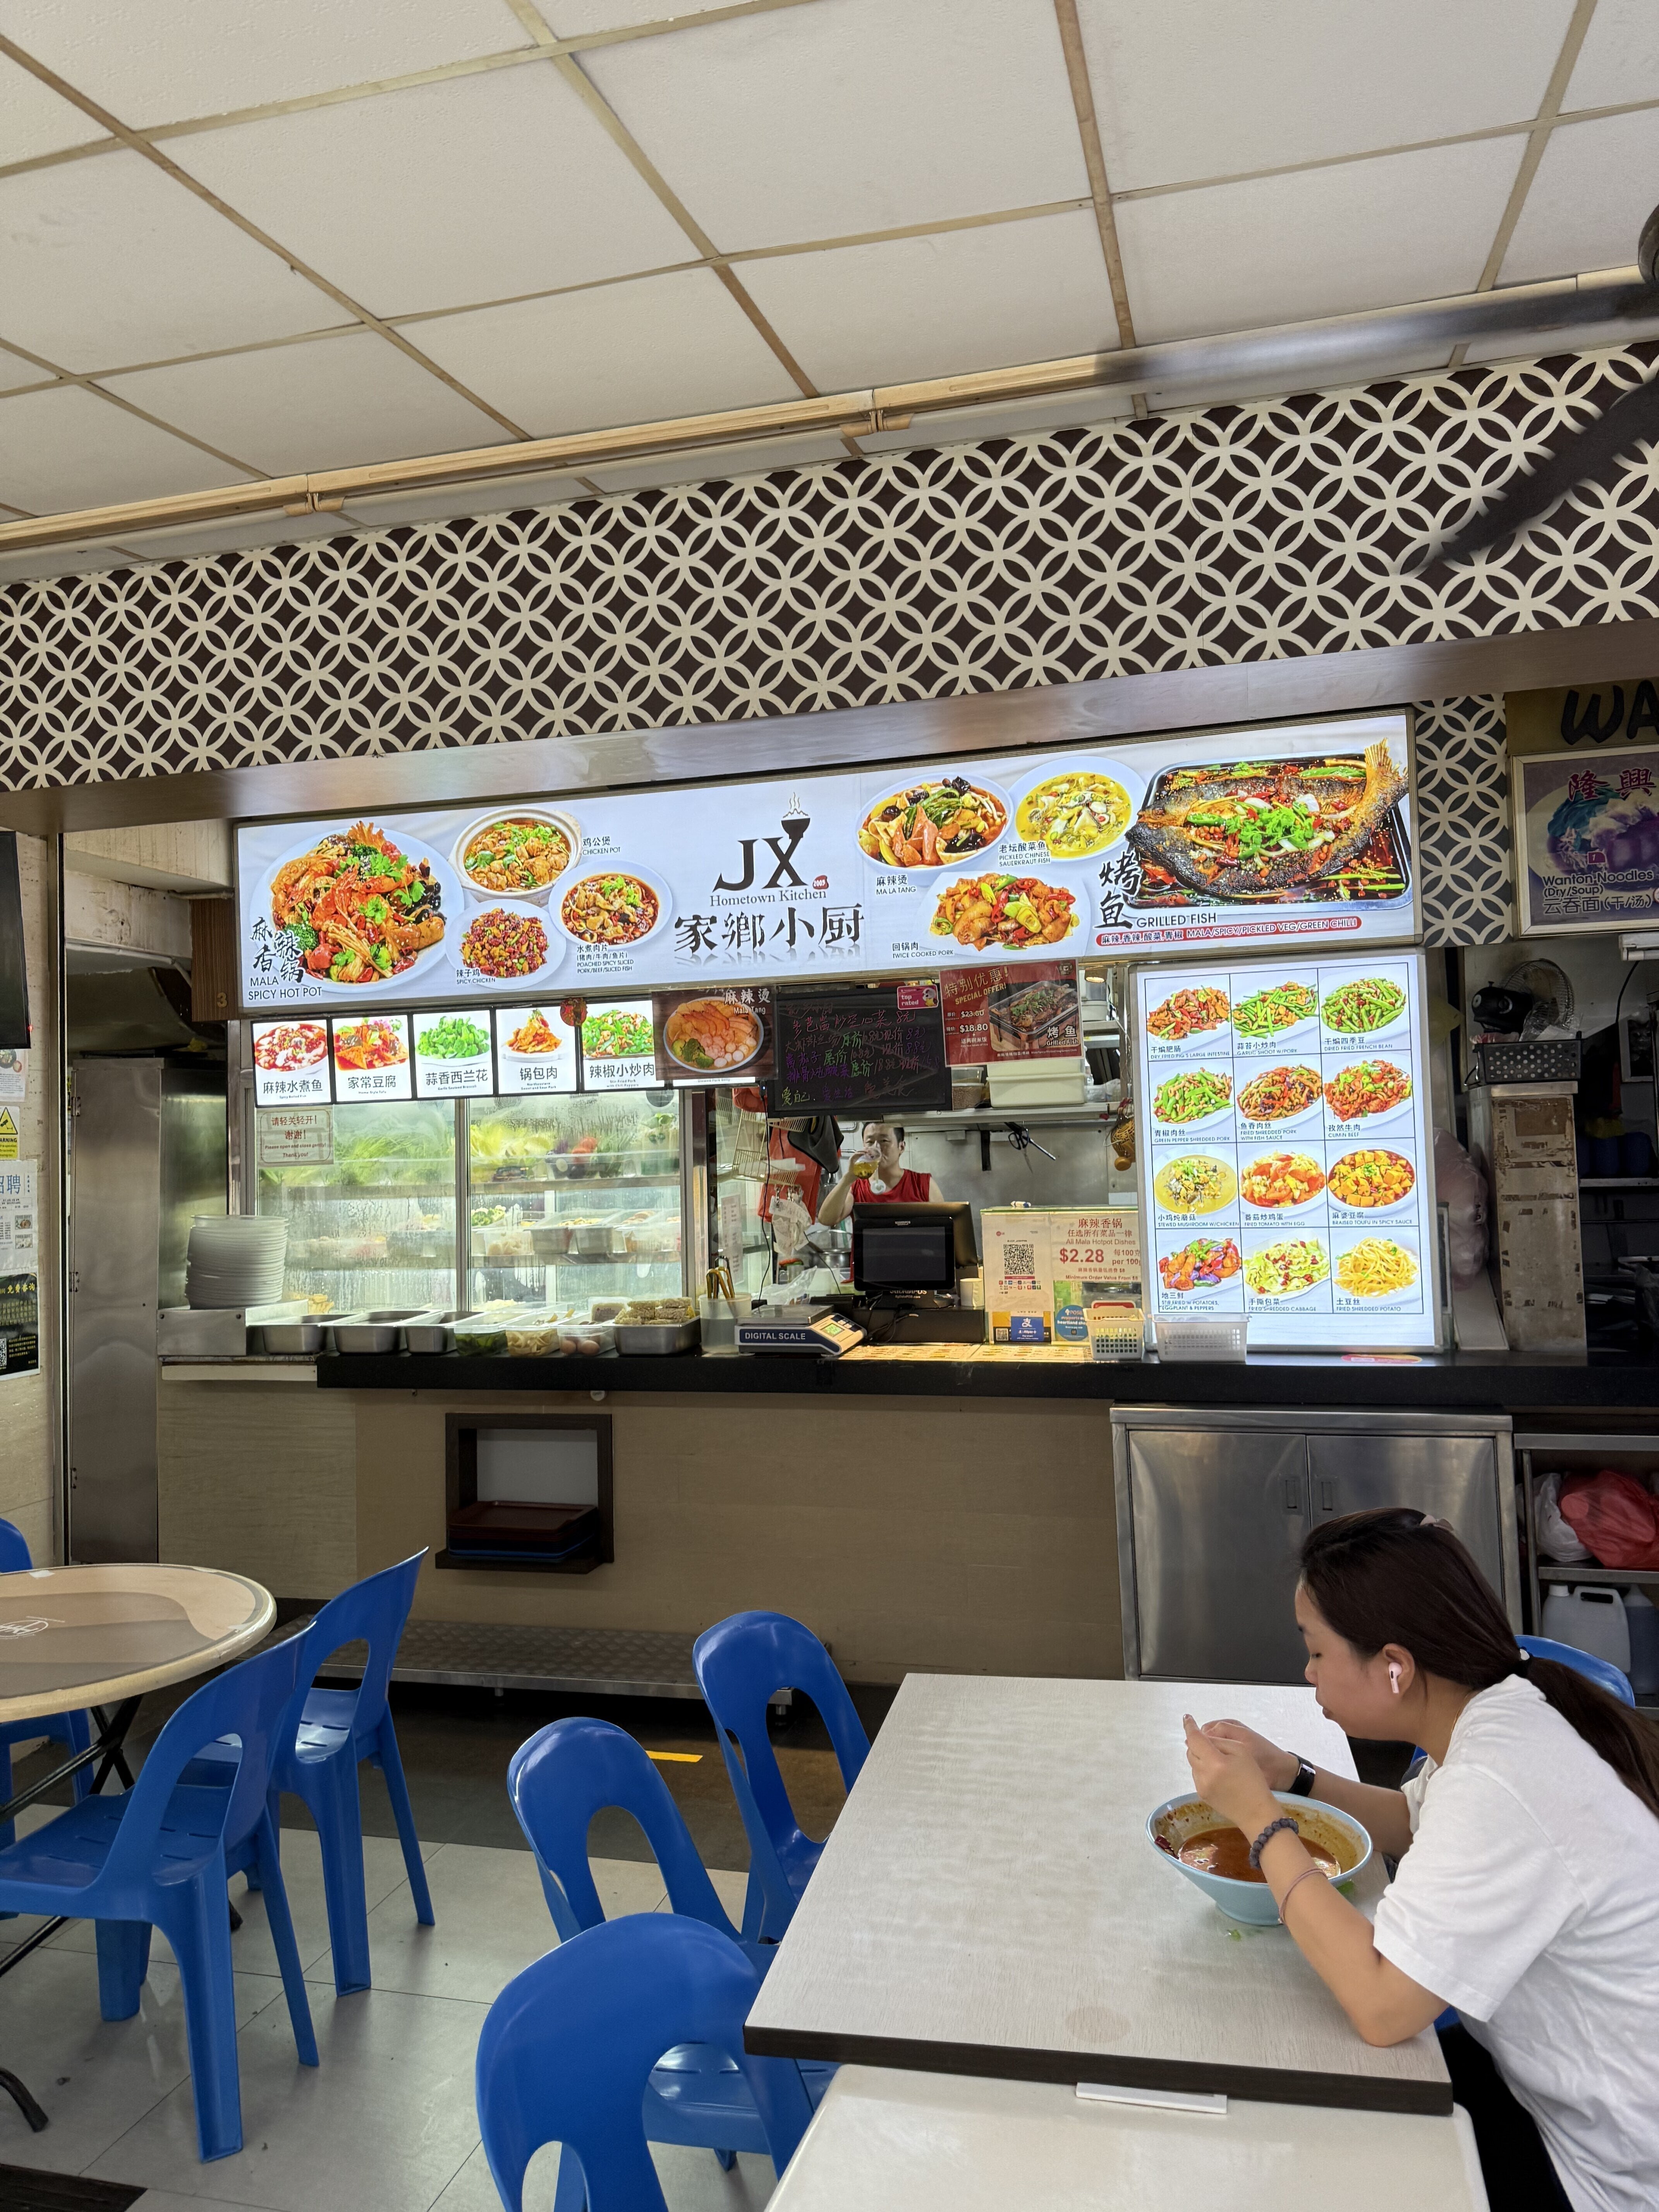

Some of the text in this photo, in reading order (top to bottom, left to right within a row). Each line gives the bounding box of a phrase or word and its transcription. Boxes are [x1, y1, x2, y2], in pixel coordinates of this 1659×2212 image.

[1568, 768, 1656, 802] 隆興
[583, 836, 610, 847] 鸡公煲
[999, 842, 1046, 853] 老坛酸菜鱼
[712, 836, 809, 892] JX
[876, 874, 907, 886] 麻辣烫
[1543, 871, 1653, 886] Wanton Noodles
[1094, 850, 1140, 929] 烤鱼
[1544, 884, 1604, 897] (Dry/Soup)
[710, 890, 826, 907] Hometown Kitchen
[1137, 913, 1216, 927] GRILLED FISH
[1331, 918, 1357, 927] CHILLI
[674, 903, 864, 954] 家鄉小厨
[577, 944, 607, 953] 水煮肉片
[892, 942, 918, 951] 回锅肉
[456, 969, 480, 979] 辣子鸡
[250, 976, 279, 986] MALA
[945, 966, 1008, 997] 特别优惠!
[248, 987, 322, 1000] SPICY HOT POT
[724, 988, 771, 1004] 麻辣烫
[955, 983, 1006, 1005] SPECIAL OFFER!
[751, 1006, 766, 1015] Tang
[960, 1023, 988, 1034] $18.80
[1048, 1025, 1077, 1038] 烤鱼
[426, 1068, 488, 1085] 蒜香西兰花
[520, 1066, 557, 1081] 锅包肉
[590, 1062, 654, 1079] 辣椒小炒肉
[263, 1079, 323, 1094] 麻辣水煮鱼
[348, 1075, 396, 1089] 家常豆腐
[271, 1115, 317, 1126] 请轻关轻开!
[285, 1130, 306, 1140] 谢谢!
[1079, 1218, 1122, 1228] 麻辣香锅
[1068, 1229, 1132, 1237] 任选所有菜品一律
[1060, 1247, 1104, 1264] $2.28
